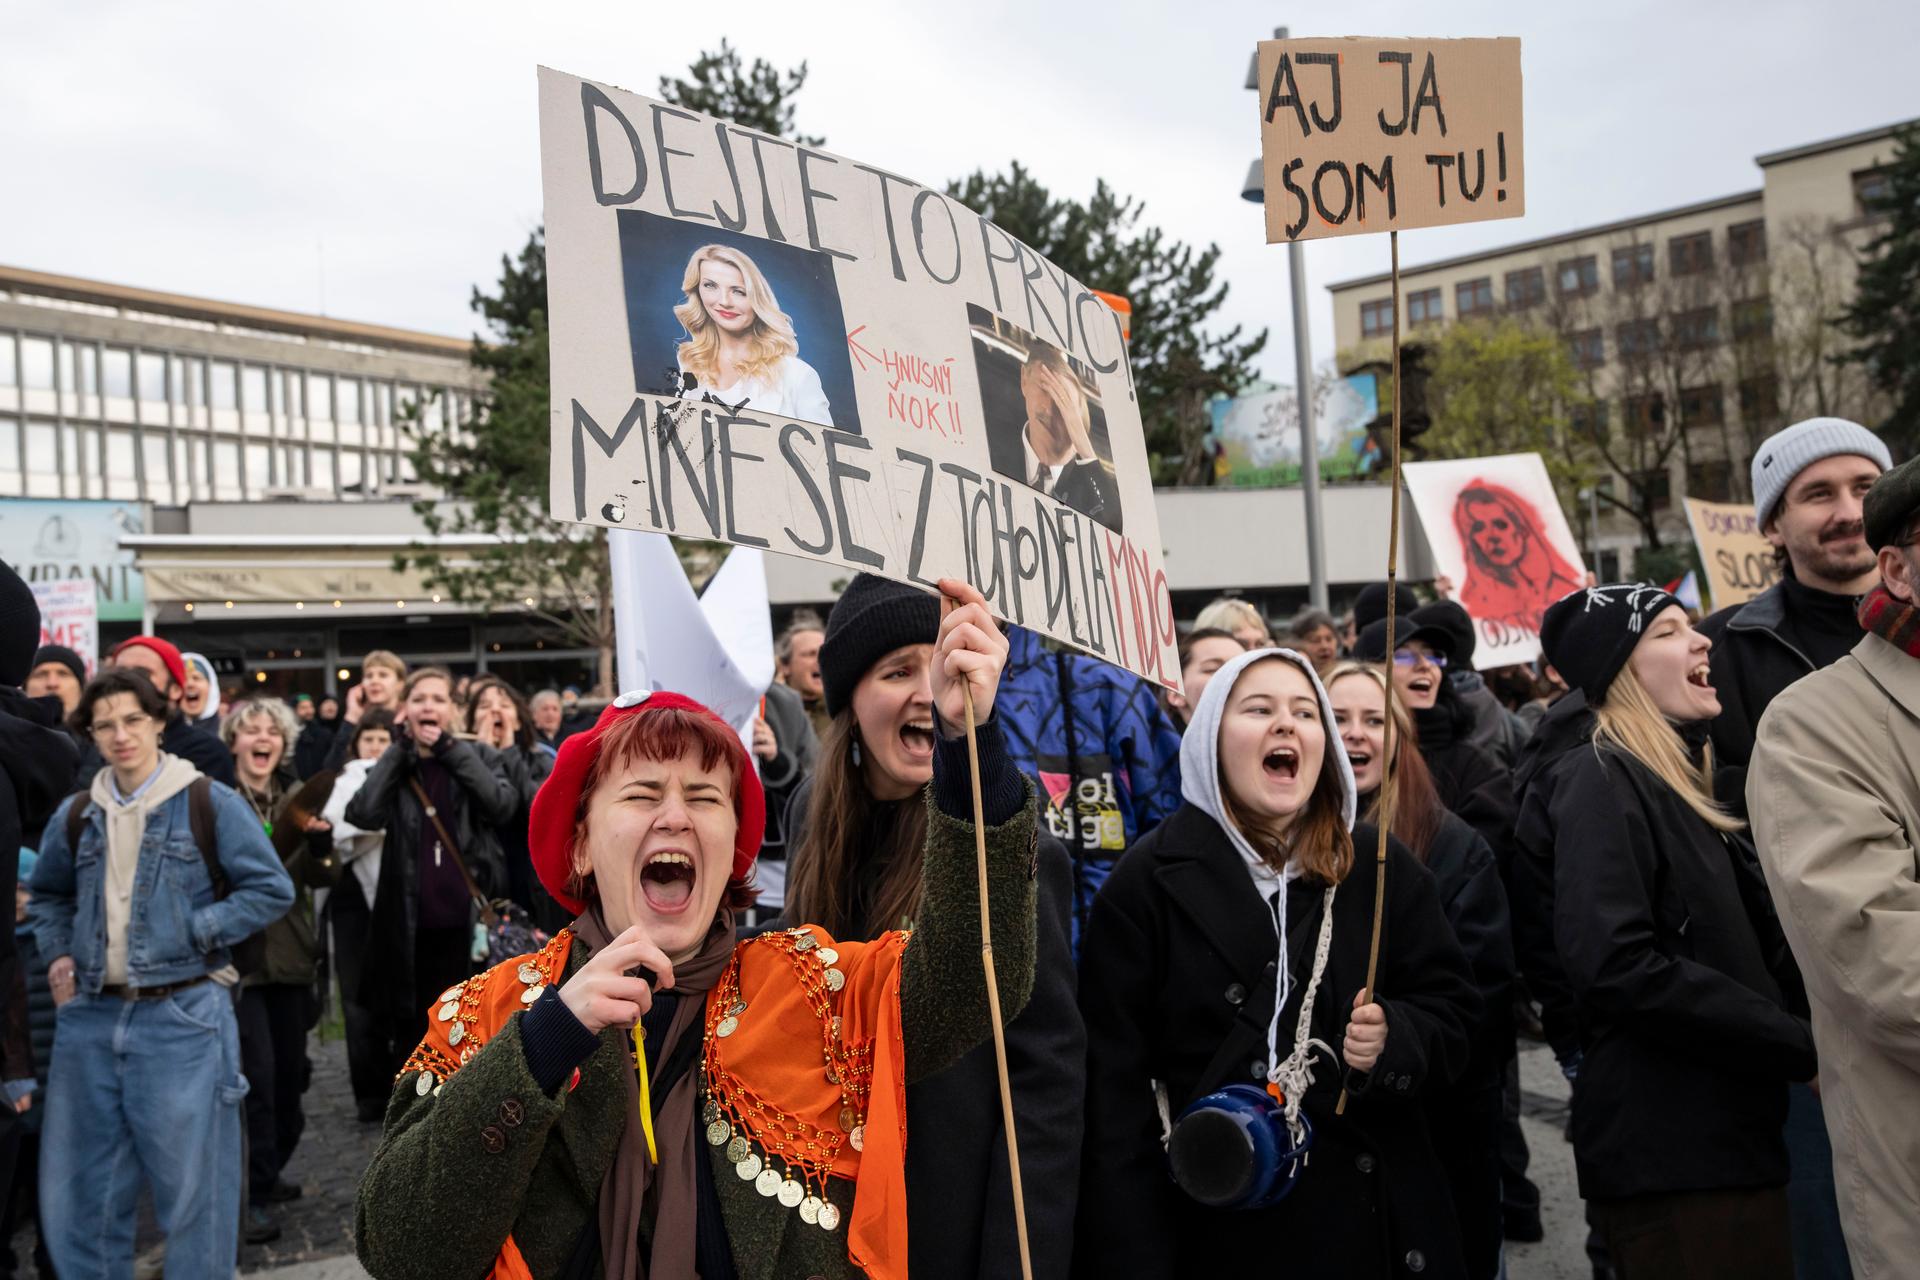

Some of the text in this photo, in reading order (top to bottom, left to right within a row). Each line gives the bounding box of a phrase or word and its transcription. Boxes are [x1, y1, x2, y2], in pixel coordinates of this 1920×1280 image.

[1265, 51, 1447, 138] AJ JA
[581, 81, 859, 262] DEJTE
[852, 163, 962, 285] TO
[1282, 131, 1507, 240] SOM TU!
[778, 423, 886, 571] SE
[896, 446, 942, 589] Z
